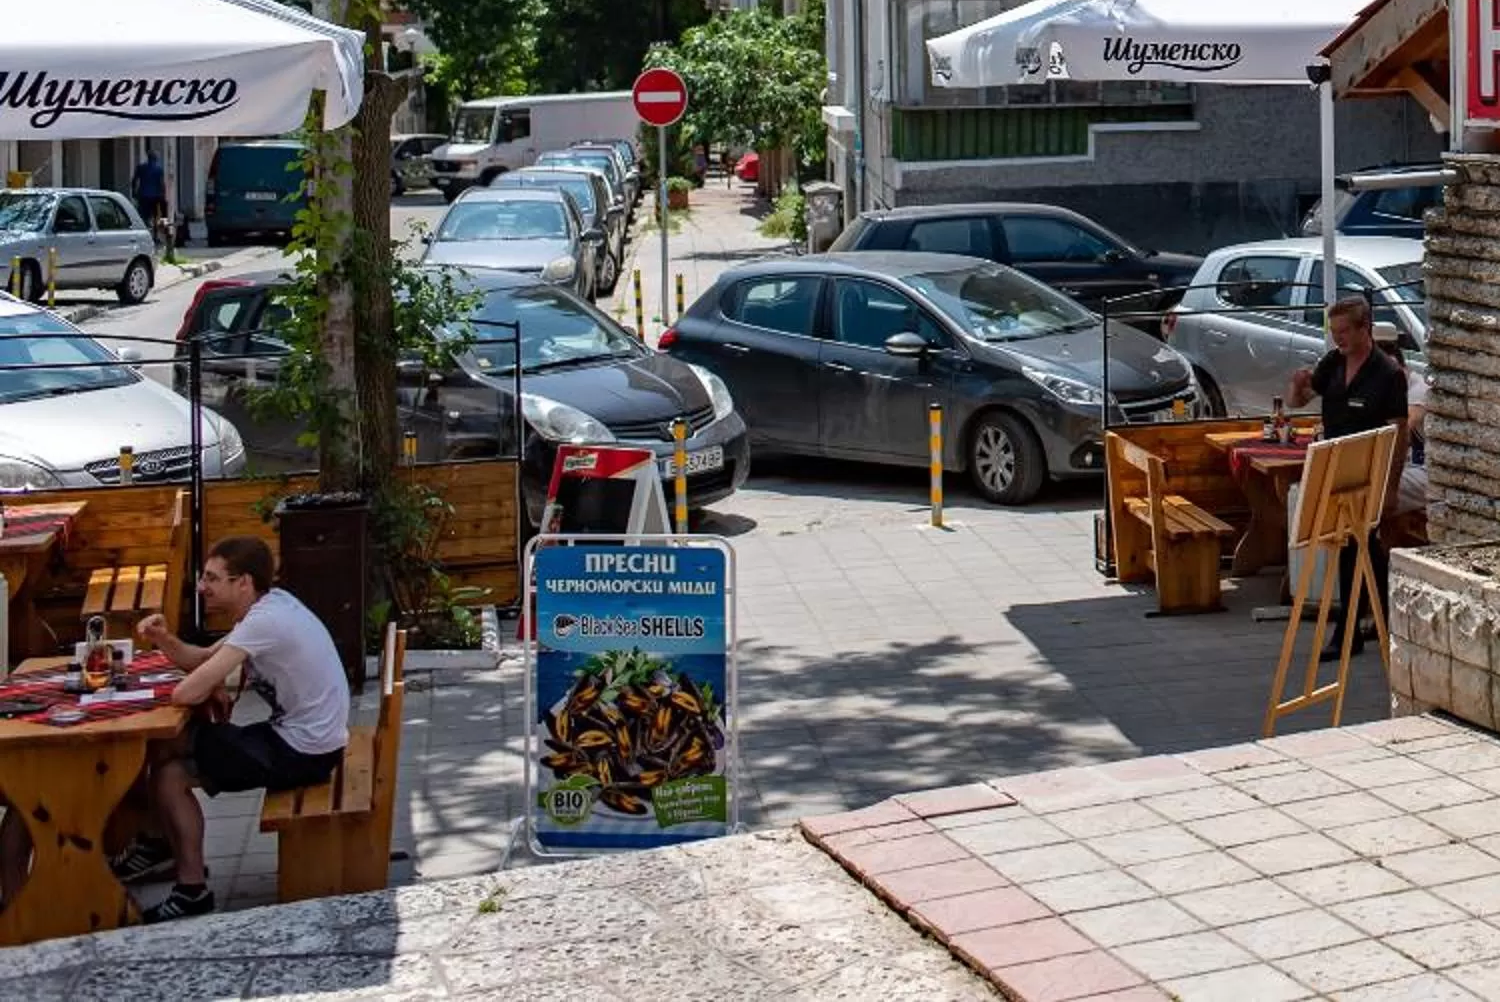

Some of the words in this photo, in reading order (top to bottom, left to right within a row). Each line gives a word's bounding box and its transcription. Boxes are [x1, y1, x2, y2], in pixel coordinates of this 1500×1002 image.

[1103, 37, 1245, 75] Шуменско
[0, 71, 239, 129] Шуменско
[585, 553, 677, 574] ПРЕСНИ
[545, 579, 664, 594] ЧЕРНОМОРСКИ
[667, 581, 717, 595] МИДИ
[641, 616, 705, 637] SHELLS
[553, 791, 584, 809] BIO
